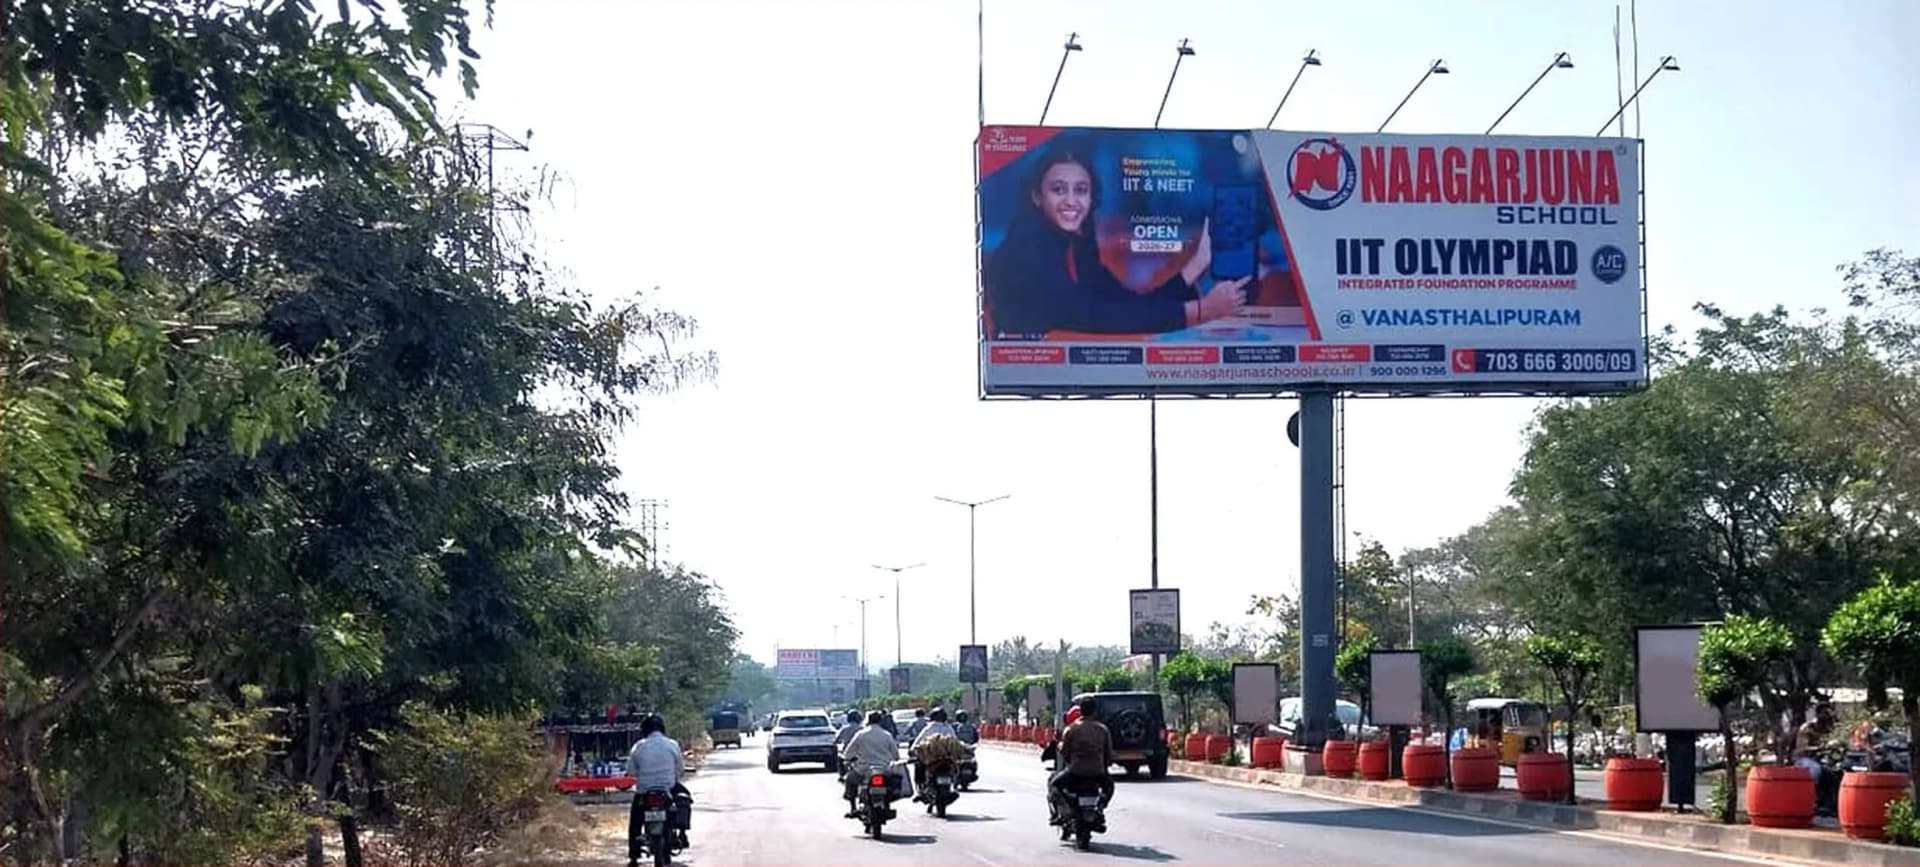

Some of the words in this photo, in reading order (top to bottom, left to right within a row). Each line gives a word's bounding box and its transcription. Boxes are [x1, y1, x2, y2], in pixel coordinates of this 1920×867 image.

[1360, 146, 1619, 204] NAAGARJUNA
[1122, 178, 1140, 192] IIT
[1144, 178, 1153, 192] &
[1157, 179, 1195, 192] NEET
[1496, 206, 1618, 225] SCHOOL
[1134, 225, 1178, 239] OPEN
[1336, 239, 1384, 275] IIT
[1394, 239, 1578, 276] OLYMPIAD
[1596, 253, 1623, 269] A/C
[1338, 279, 1414, 289] INTEGRATED
[1417, 279, 1496, 289] FOUNDATION
[1500, 279, 1577, 290] PROGRAMME
[1336, 310, 1355, 329] @
[1361, 309, 1581, 326] VANASTHALIPURAM
[1486, 353, 1518, 370] 703
[1524, 353, 1556, 371] 666
[1562, 353, 1632, 372] 3006/09
